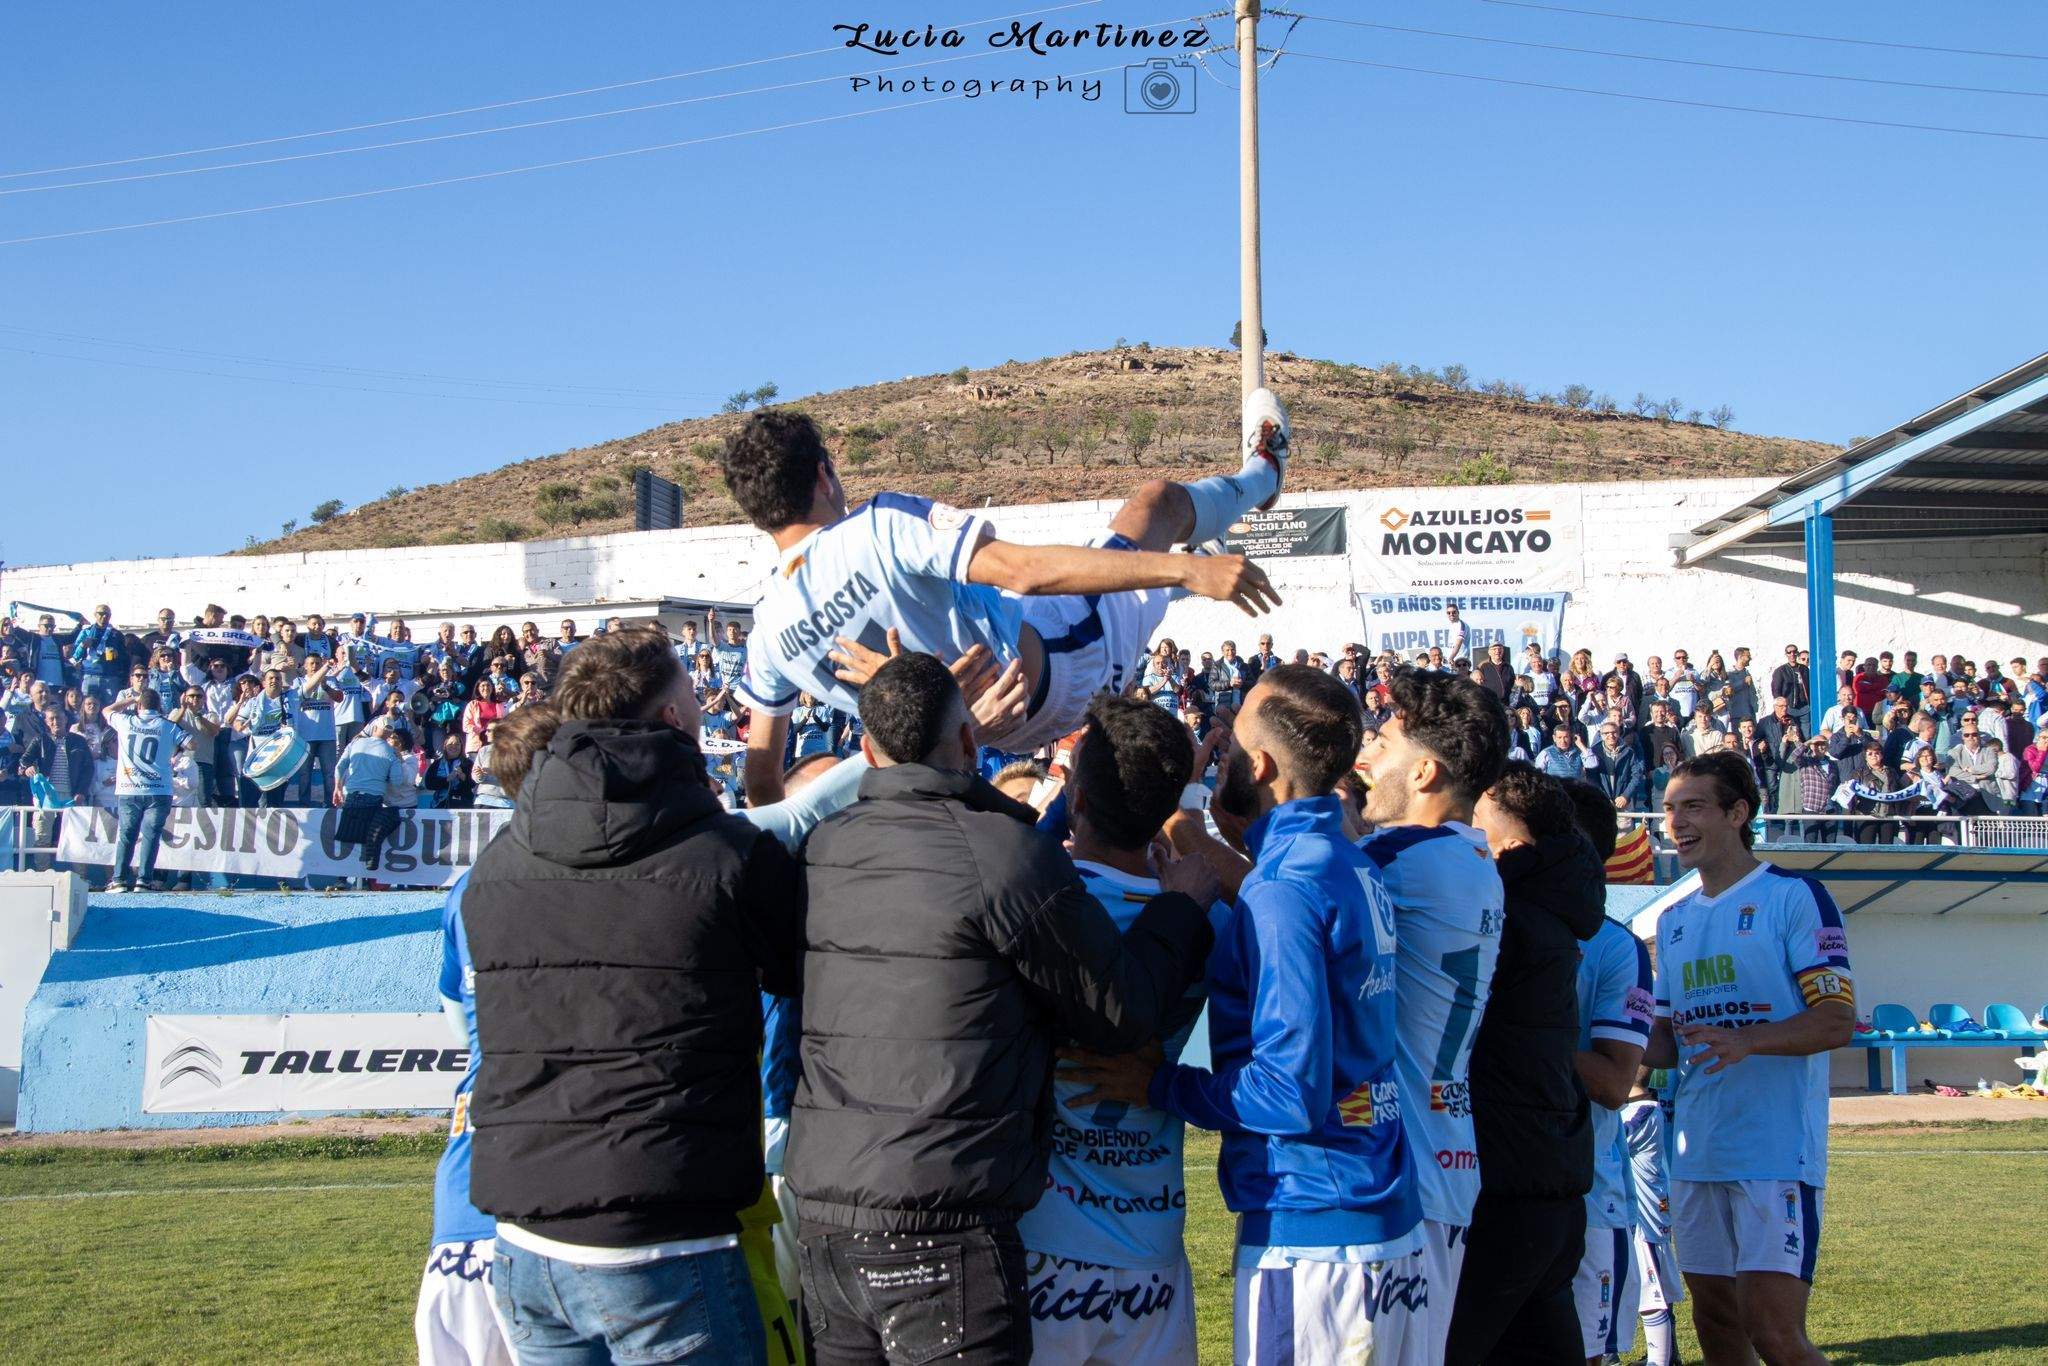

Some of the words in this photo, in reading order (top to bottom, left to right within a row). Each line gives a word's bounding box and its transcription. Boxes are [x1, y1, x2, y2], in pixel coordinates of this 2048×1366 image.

[1241, 512, 1294, 523] TALLERES
[1409, 508, 1524, 527] AZULEJOS
[1381, 529, 1552, 556] MONCAYO
[1411, 578, 1523, 587] AZULEJOSMONCAYO.COM
[1371, 599, 1393, 614] 50
[1398, 594, 1442, 612] AÑOS
[1470, 596, 1555, 612] FELICIDAD
[1381, 630, 1431, 650] AUPA
[1472, 628, 1505, 647] REA
[127, 734, 160, 765] 10
[85, 807, 299, 857] Nestro
[320, 808, 491, 873] Ogull
[1682, 954, 1736, 992] AMB
[240, 1048, 472, 1075] TALLERE
[1052, 1119, 1151, 1148] GOBIERNO
